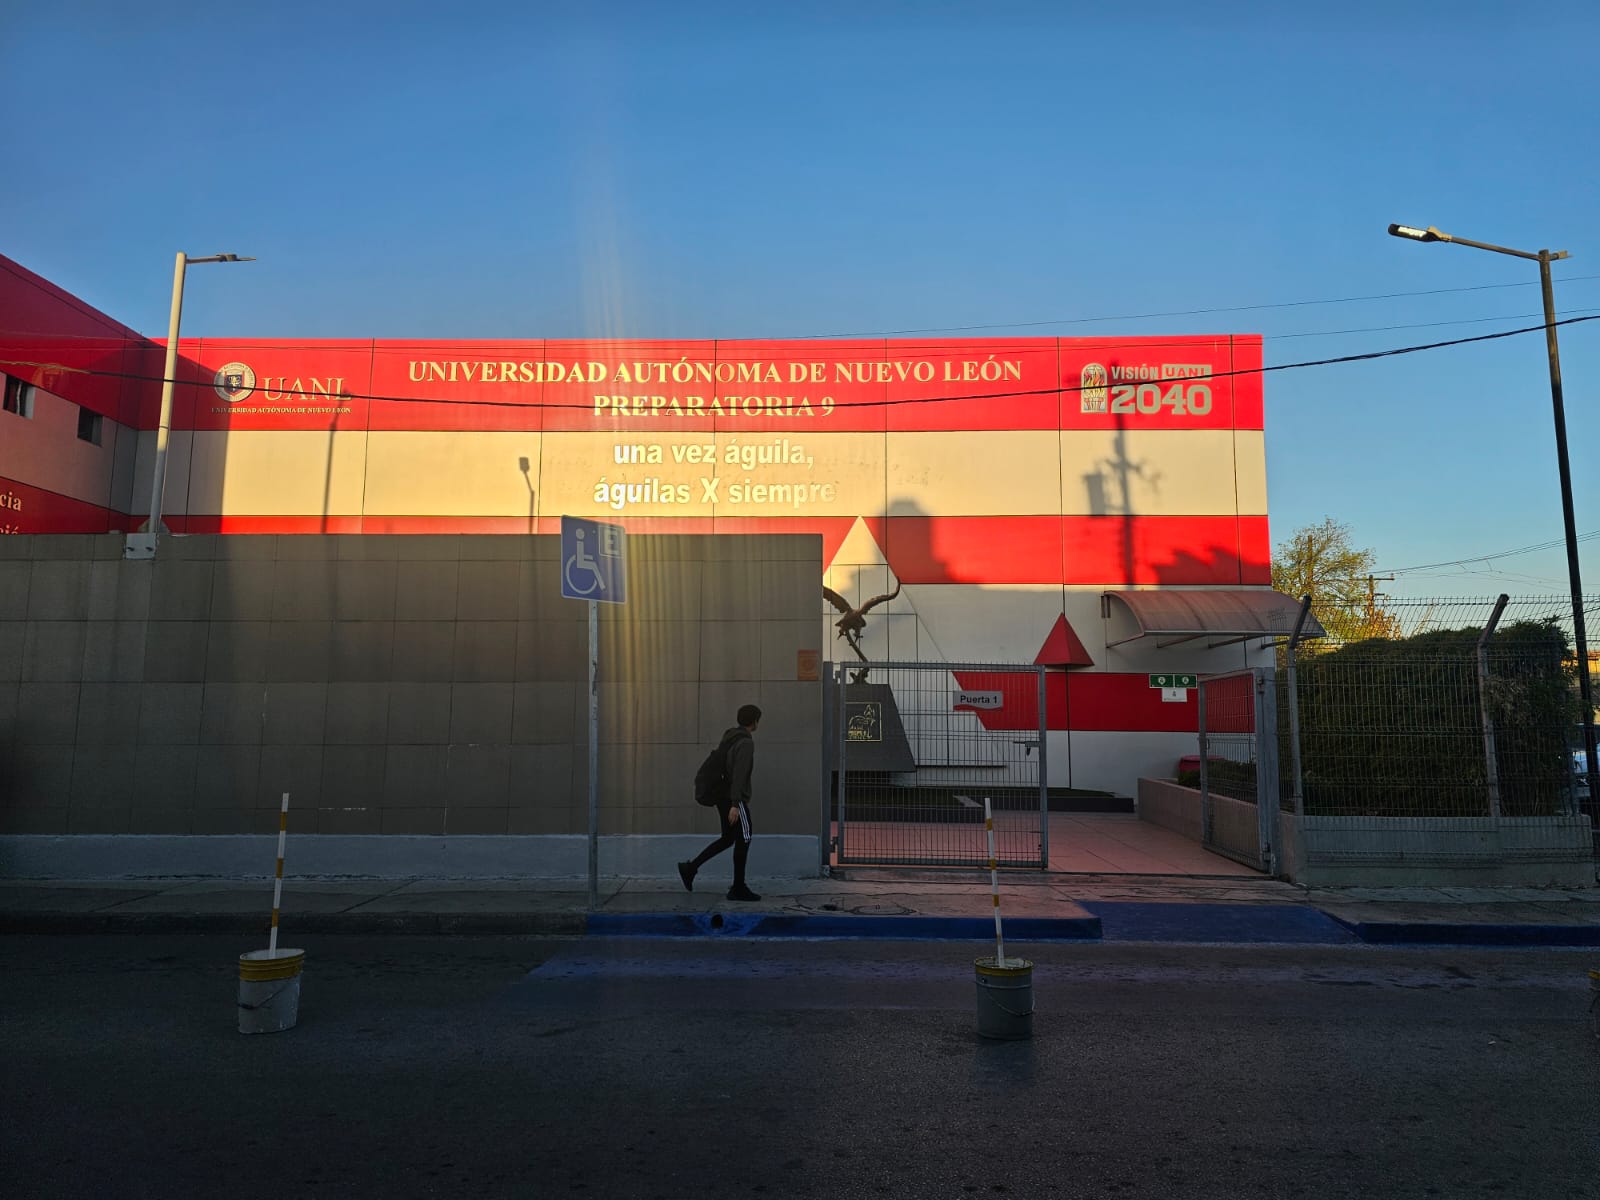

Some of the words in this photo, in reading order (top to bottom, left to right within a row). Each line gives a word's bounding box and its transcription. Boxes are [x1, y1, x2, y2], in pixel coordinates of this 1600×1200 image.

[409, 361, 607, 383] UNIVERSIDAD
[615, 357, 782, 383] AUTÓNOMA
[788, 362, 826, 383] DE
[836, 361, 936, 383] NUEVO
[943, 355, 1023, 381] LEÓN
[1111, 363, 1159, 380] VISIÓN
[262, 376, 352, 401] UANL
[1111, 383, 1212, 415] 2040
[593, 395, 815, 417] PREPARATORIA
[821, 396, 835, 417] 9
[614, 444, 663, 464] una
[671, 444, 717, 464] vez
[724, 438, 815, 470] águila,
[593, 477, 691, 510] águilas
[700, 478, 721, 503] X
[728, 478, 838, 508] siempre
[960, 695, 990, 704] Puerta
[992, 695, 998, 704] 1
